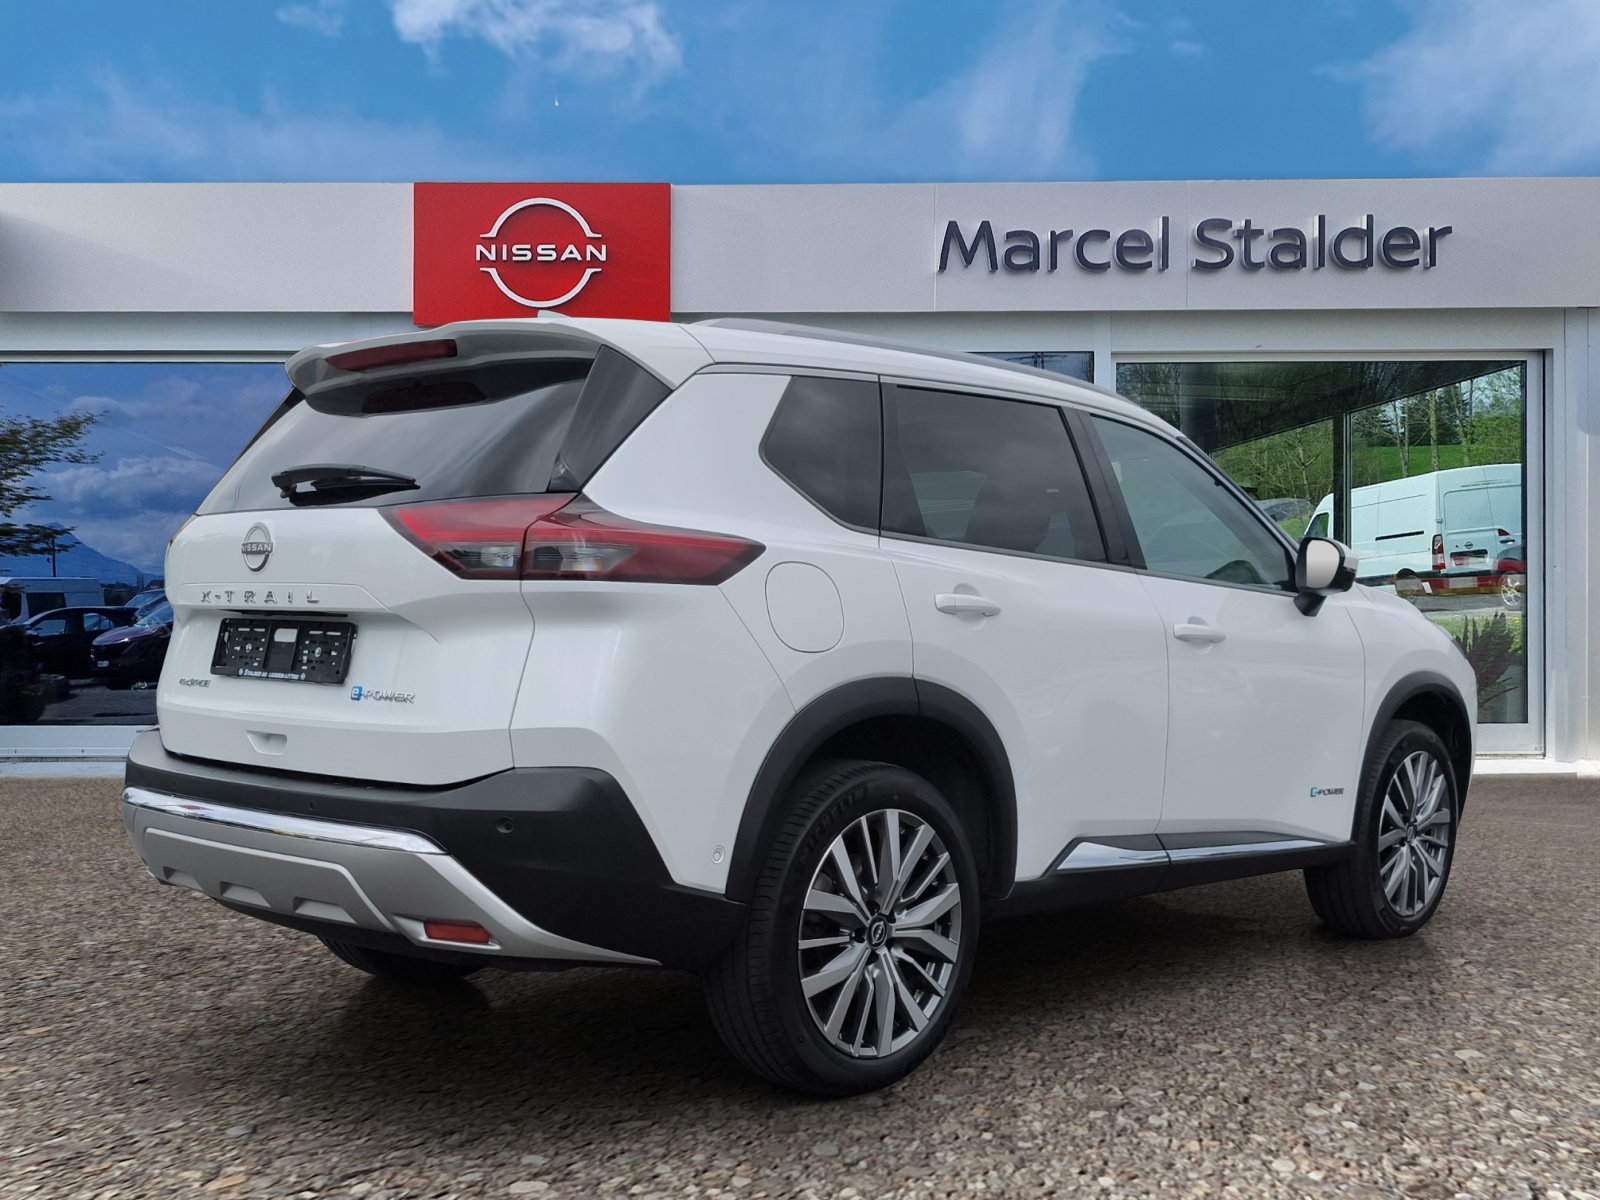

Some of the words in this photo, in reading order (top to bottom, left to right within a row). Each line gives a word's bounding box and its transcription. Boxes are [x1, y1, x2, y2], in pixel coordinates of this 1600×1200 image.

[938, 216, 1170, 272] Marcel
[1191, 213, 1453, 273] Stalder
[475, 244, 607, 262] NISSAN
[241, 543, 272, 553] NISSAN
[201, 590, 319, 603] X-TRAIL
